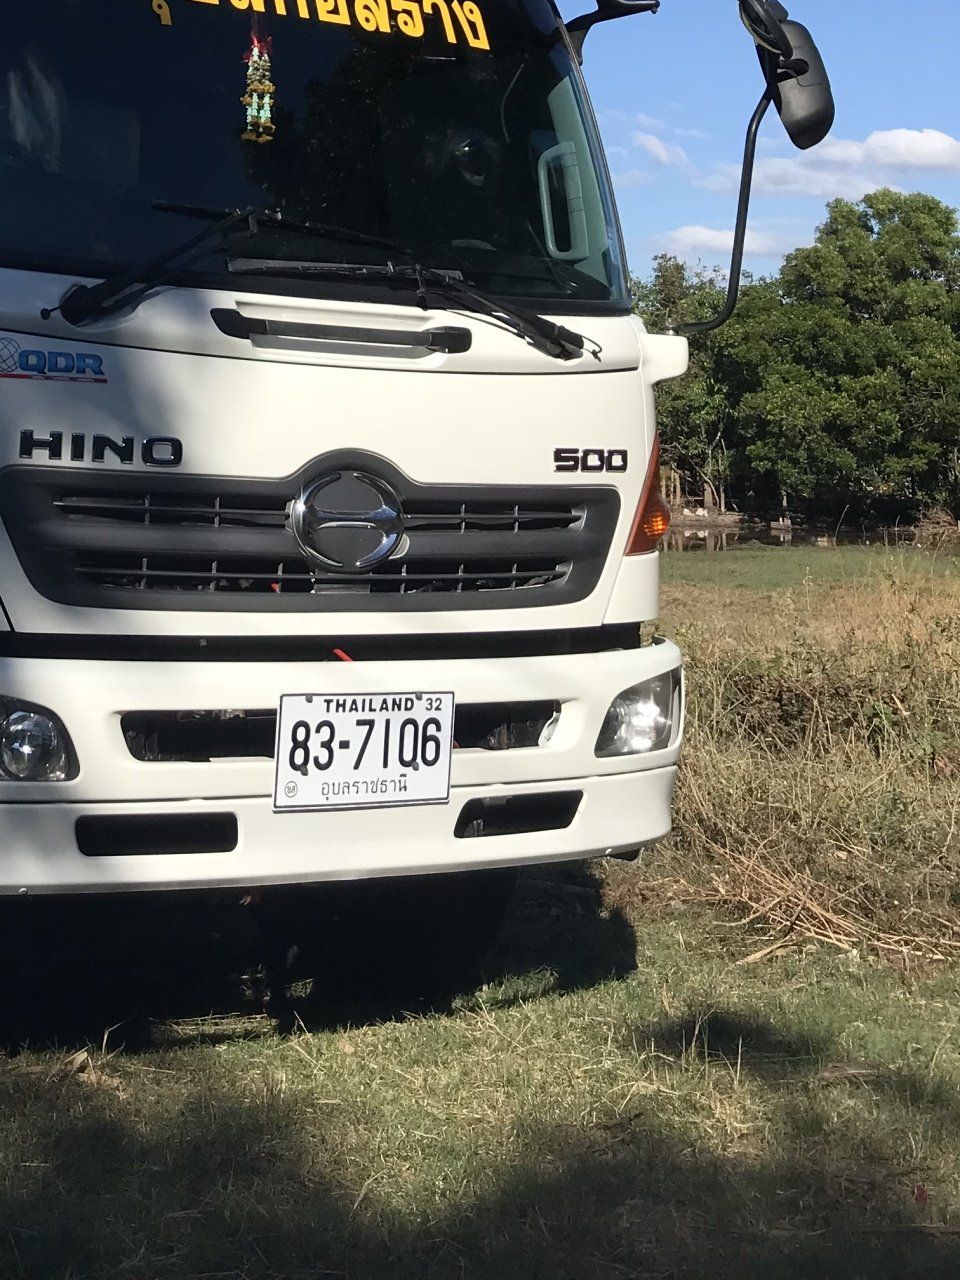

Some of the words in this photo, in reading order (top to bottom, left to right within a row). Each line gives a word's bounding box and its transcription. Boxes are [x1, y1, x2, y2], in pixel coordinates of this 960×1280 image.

[18, 349, 105, 375] QDR
[19, 429, 183, 467] HINO
[553, 447, 628, 472] 500
[323, 697, 415, 713] THAILAND
[425, 697, 442, 711] 32
[289, 717, 442, 772] 83-7106
[321, 773, 408, 800] อุบลราชธานี
